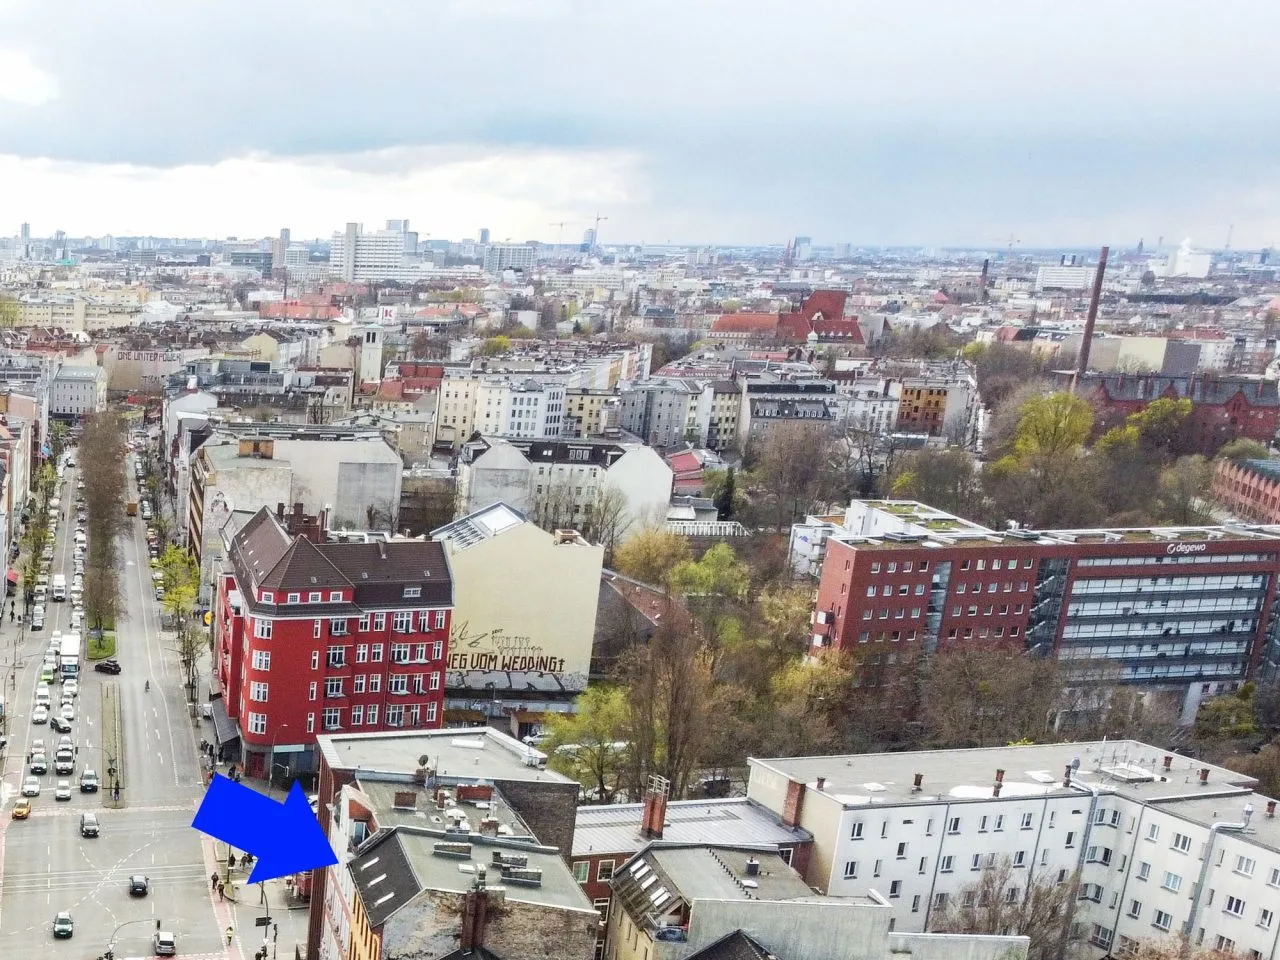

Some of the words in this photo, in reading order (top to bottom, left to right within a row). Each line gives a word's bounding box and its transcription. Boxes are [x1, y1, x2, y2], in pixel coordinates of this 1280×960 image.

[117, 351, 132, 361] ONE
[1176, 542, 1206, 554] degewo
[470, 652, 498, 670] VOM
